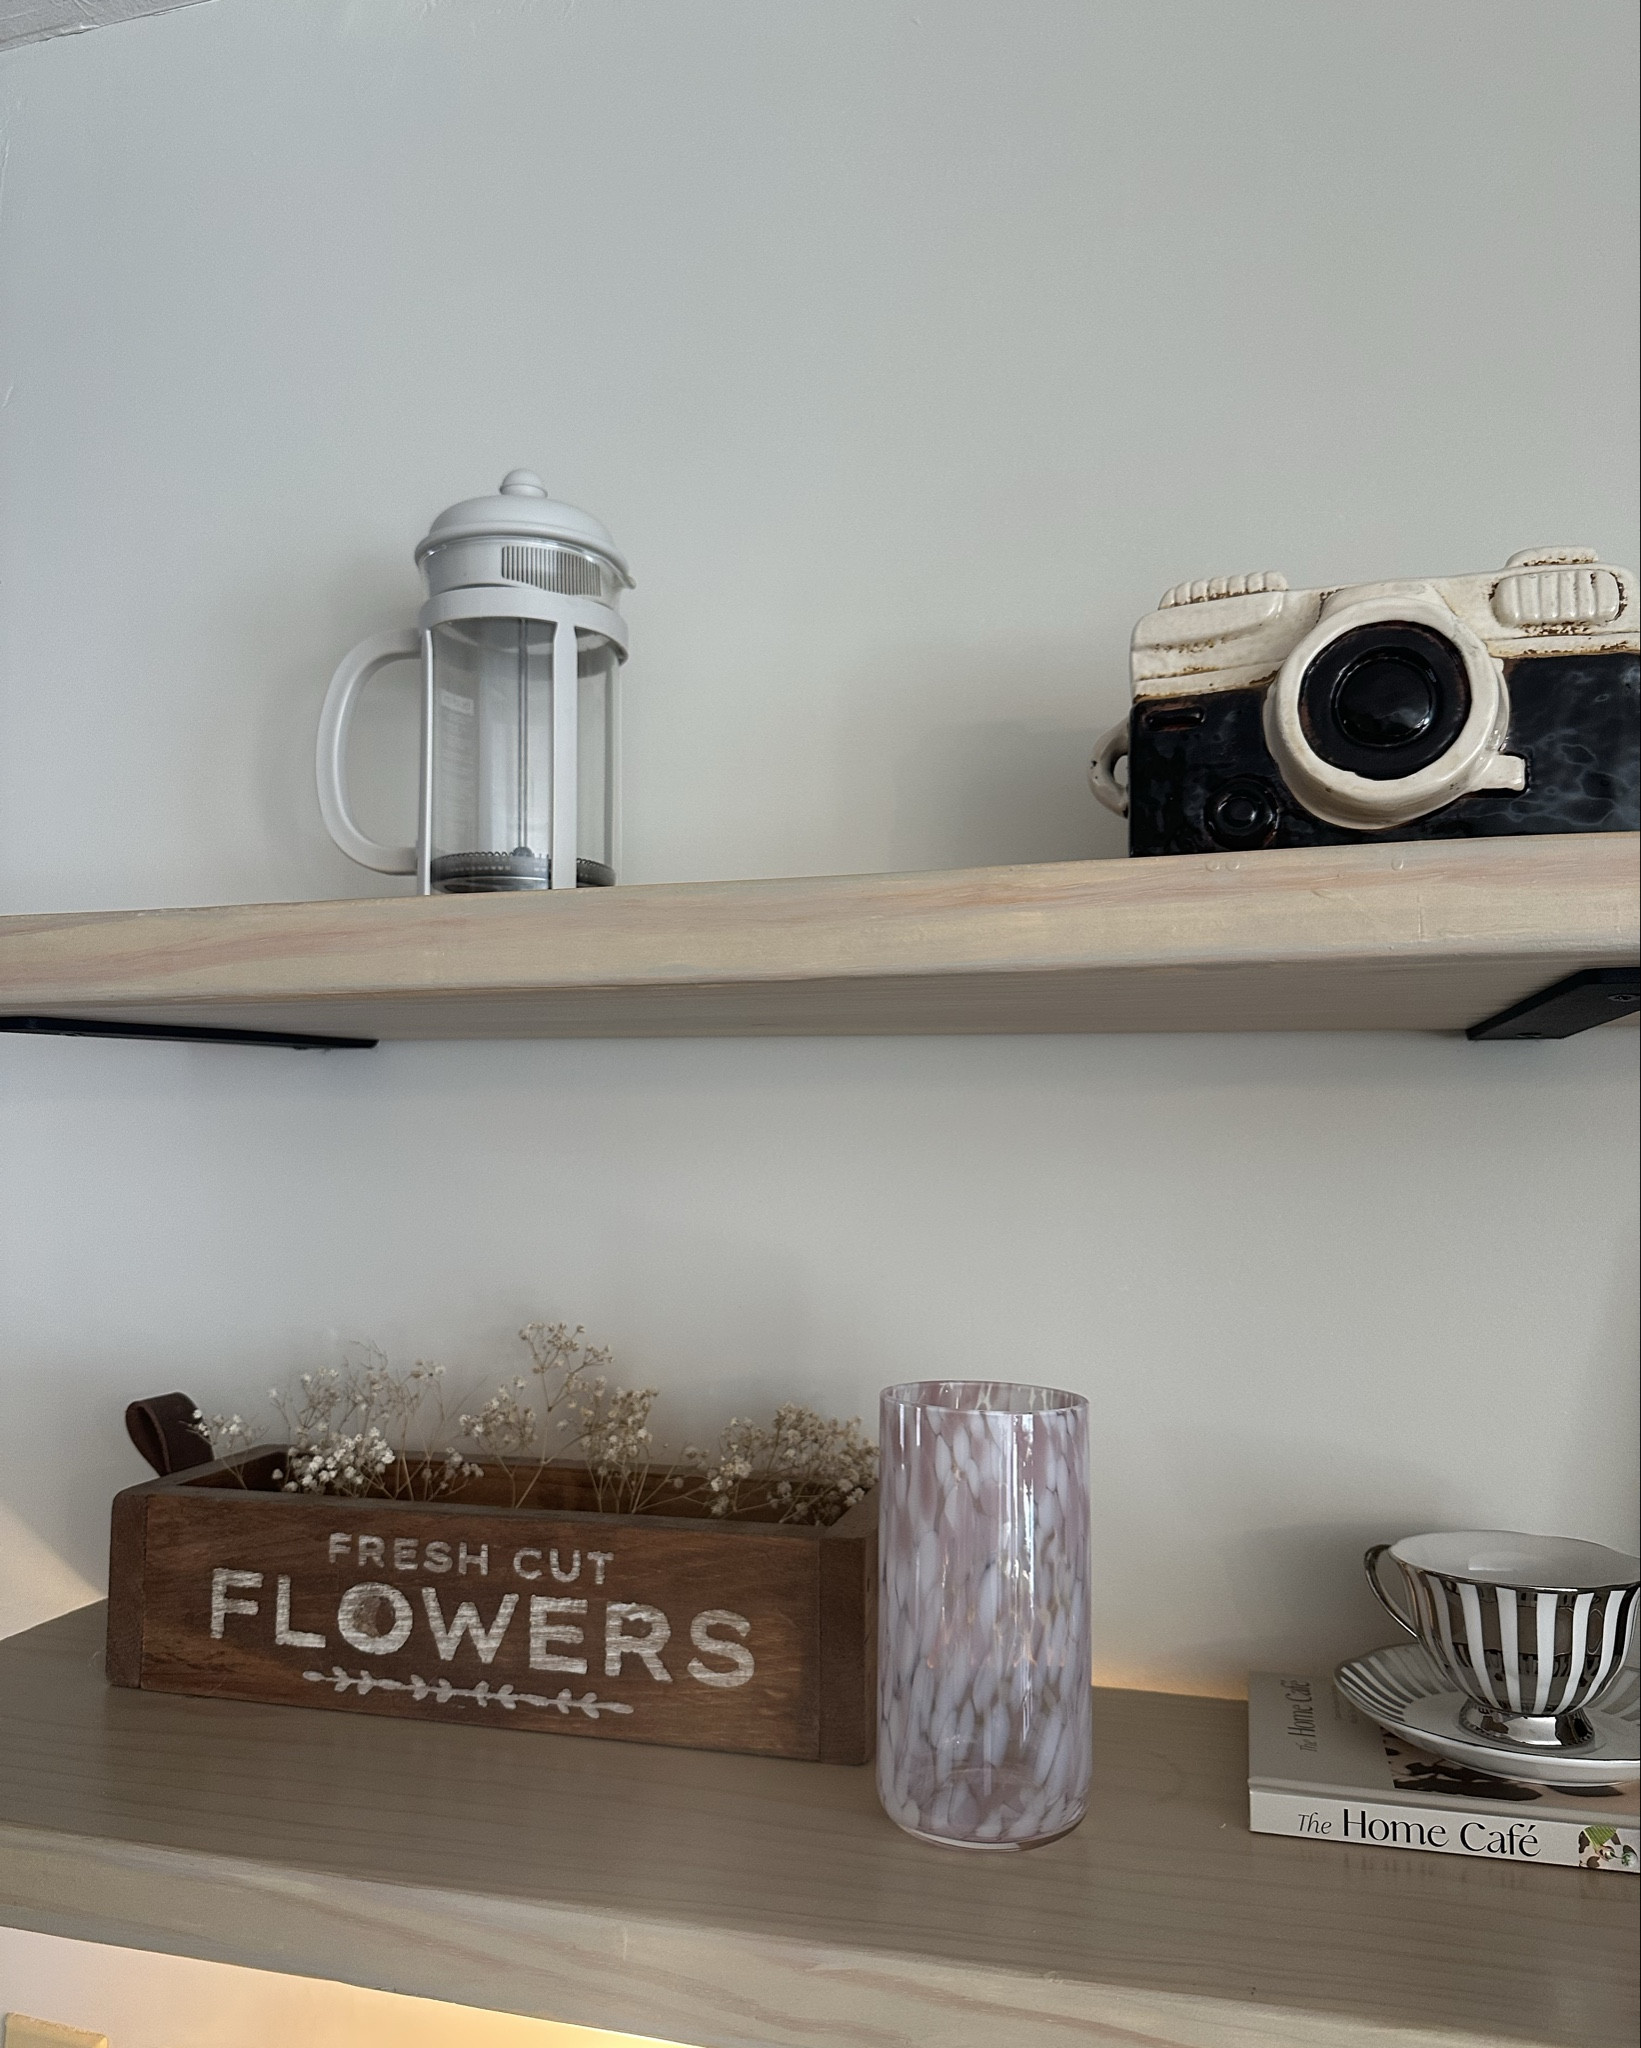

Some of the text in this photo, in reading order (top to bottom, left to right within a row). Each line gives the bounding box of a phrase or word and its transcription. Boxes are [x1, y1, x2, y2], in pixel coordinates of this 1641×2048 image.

[328, 1532, 614, 1585] FRESH CUT
[210, 1566, 756, 1688] FLOWERS
[1287, 1704, 1316, 1738] Home
[1296, 1739, 1318, 1753] The
[1298, 1808, 1541, 1857] The Home Café
